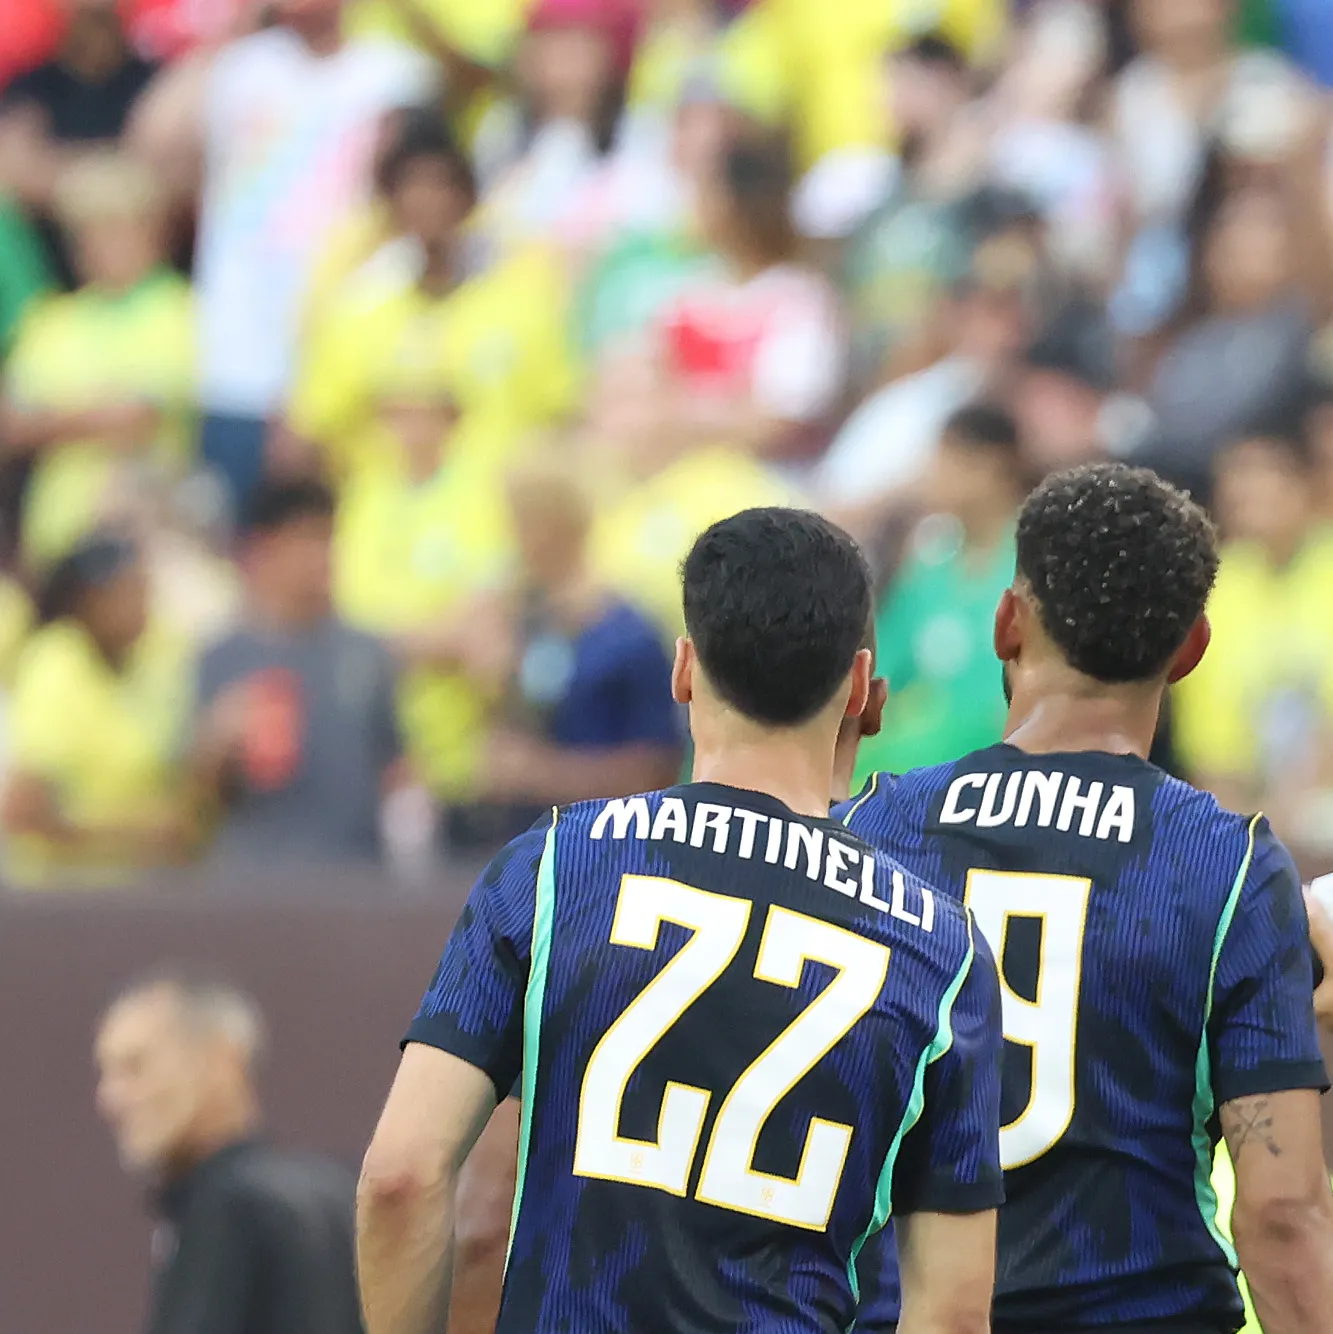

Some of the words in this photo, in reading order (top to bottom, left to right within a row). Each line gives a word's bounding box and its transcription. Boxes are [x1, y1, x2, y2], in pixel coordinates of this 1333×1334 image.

[590, 796, 935, 932] MARTINELLI
[938, 771, 1135, 843] CUNHA
[573, 874, 891, 1232] 22
[965, 868, 1092, 1171] 9
